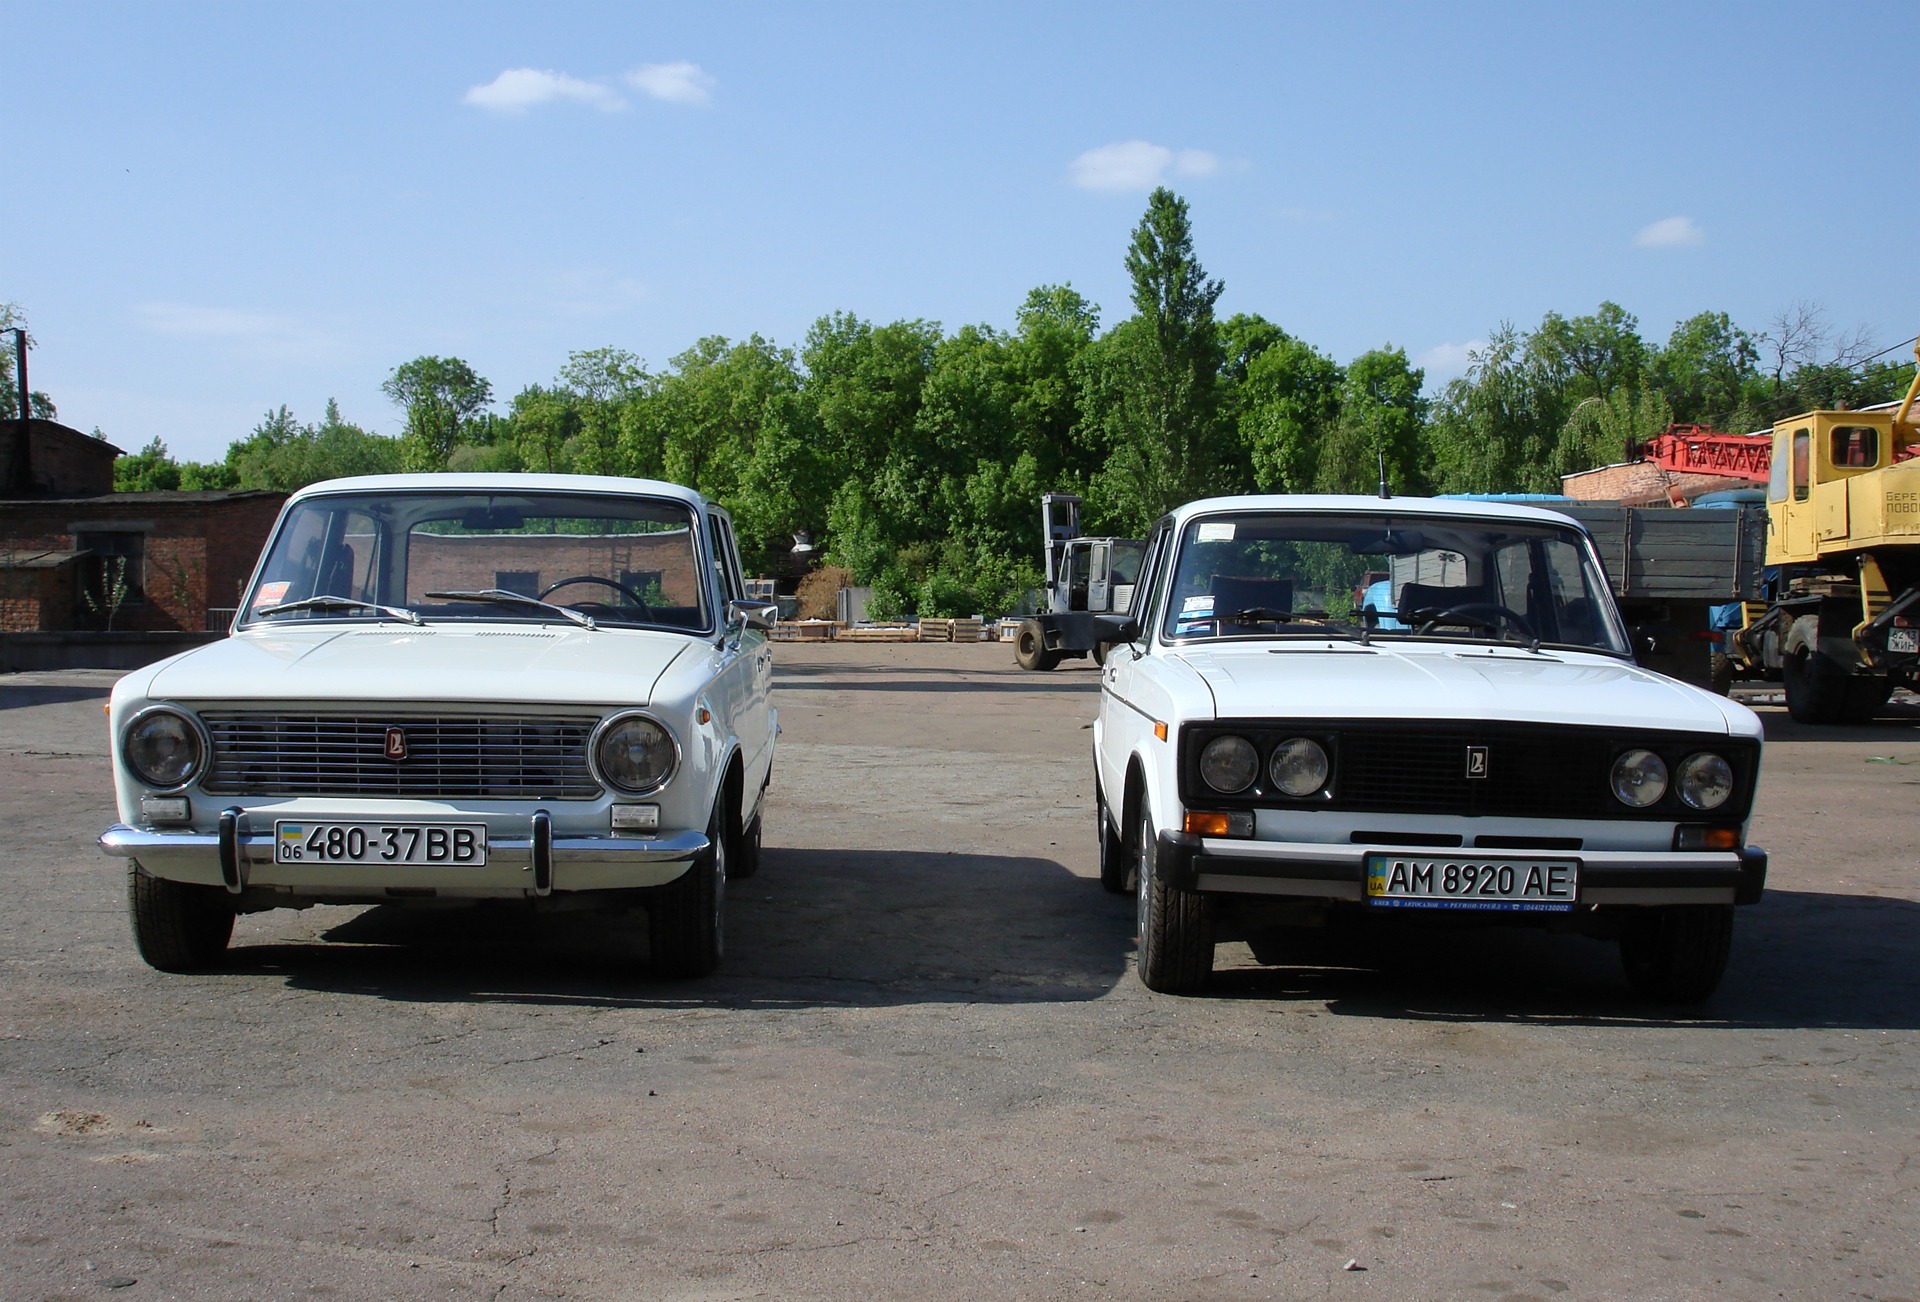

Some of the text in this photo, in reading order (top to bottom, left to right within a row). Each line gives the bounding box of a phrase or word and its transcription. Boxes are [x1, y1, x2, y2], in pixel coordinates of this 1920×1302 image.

[1886, 491, 1920, 501] БЕРЕ
[1886, 502, 1920, 513] ПОВО
[282, 845, 303, 860] 06
[1369, 861, 1569, 897] UA AM 8920 AE
